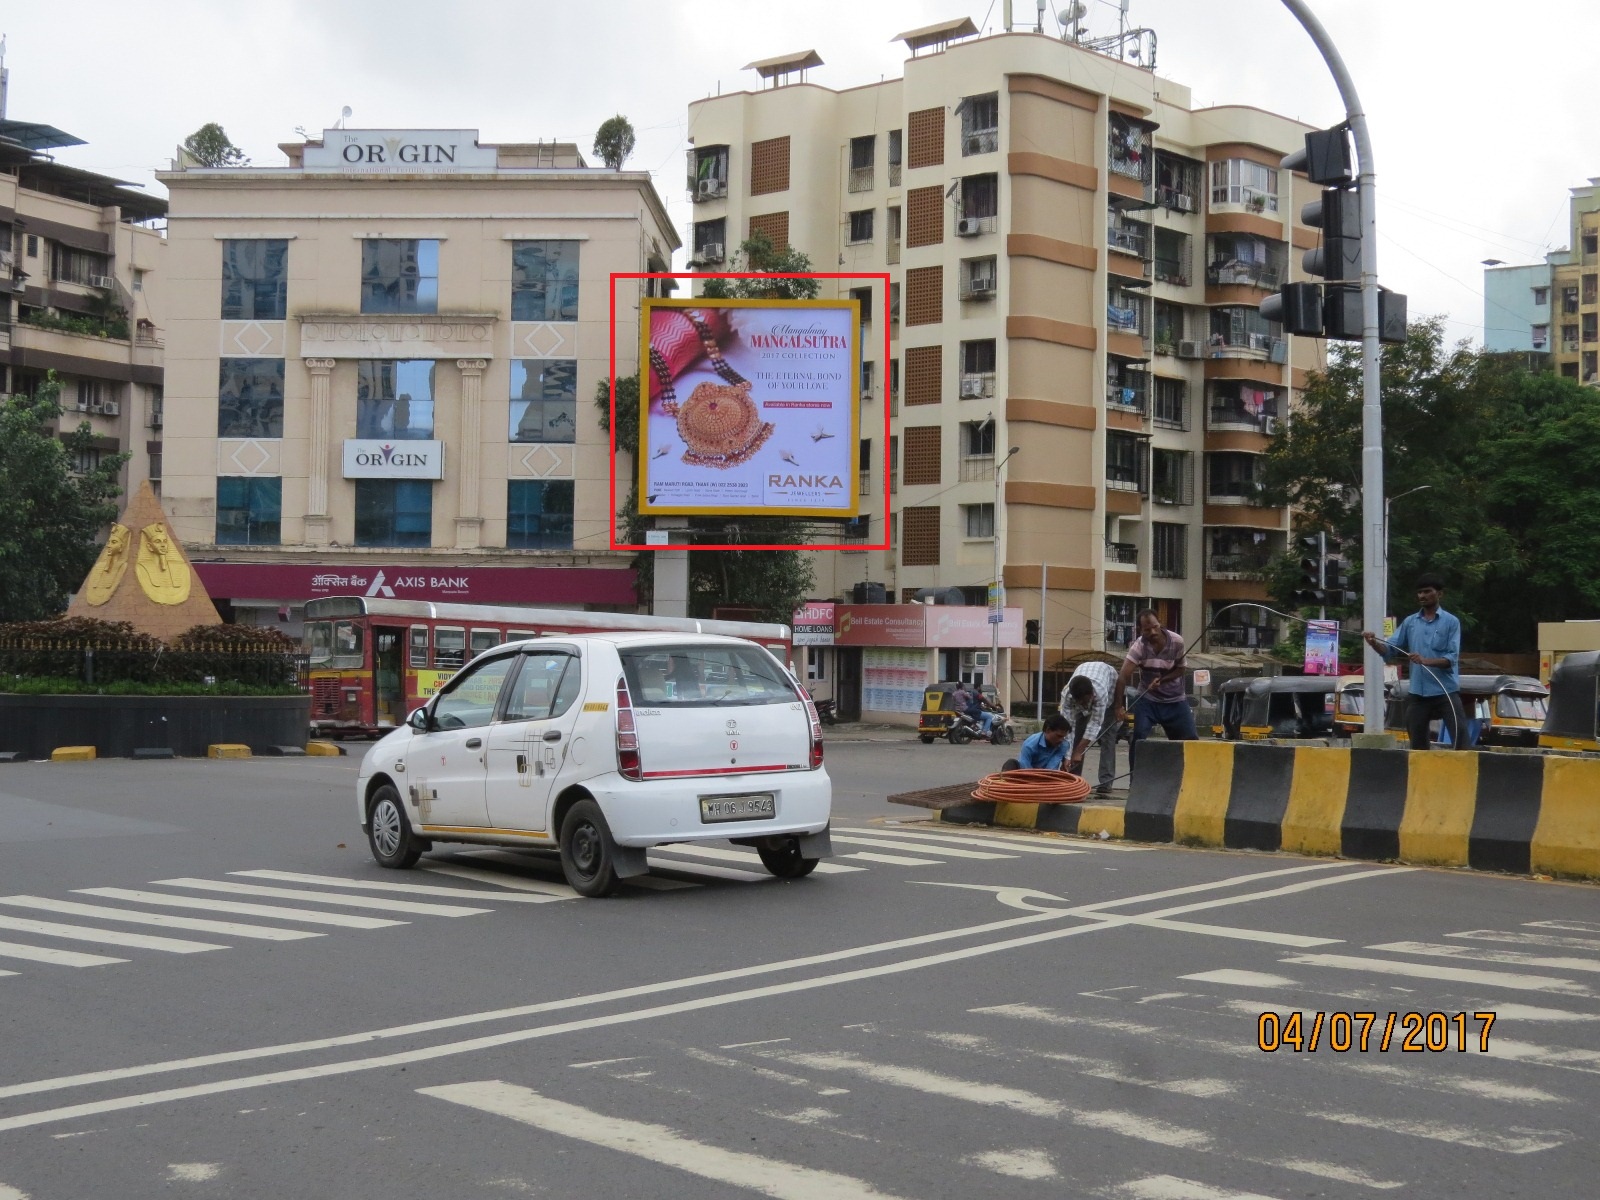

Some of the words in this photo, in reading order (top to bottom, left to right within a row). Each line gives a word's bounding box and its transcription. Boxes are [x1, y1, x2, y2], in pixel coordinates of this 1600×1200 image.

[344, 135, 358, 143] The
[751, 335, 847, 349] MANGALSUTRA
[781, 352, 836, 360] COLLECTION
[757, 372, 774, 380] THE
[776, 372, 816, 381] ETERNAL
[817, 373, 842, 381] BOND
[767, 382, 779, 390] OF
[781, 382, 805, 390] YOUR
[768, 474, 844, 489] RANKA
[394, 576, 426, 588] AXIS
[430, 577, 469, 588] BANK
[864, 617, 883, 625] Estate
[884, 617, 924, 627] Consultancy
[794, 625, 812, 633] HOME
[812, 625, 833, 633] LOANS
[747, 799, 773, 812] 9543
